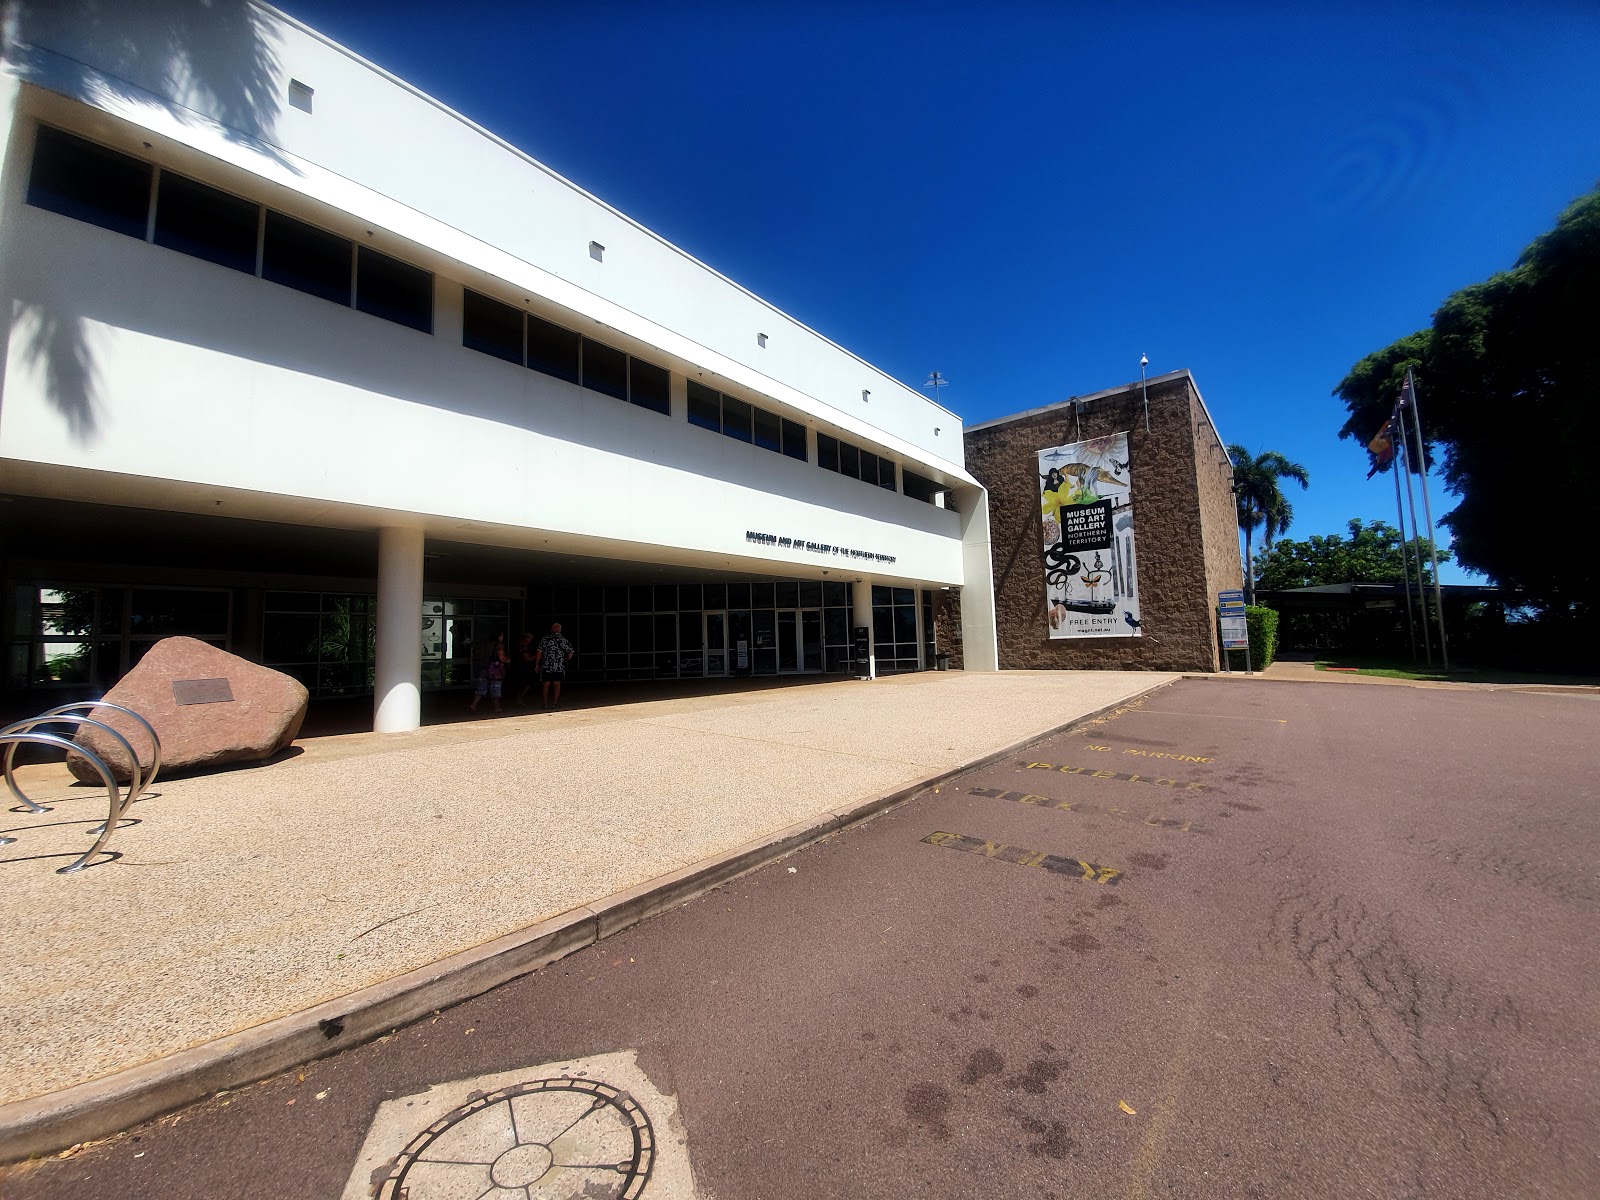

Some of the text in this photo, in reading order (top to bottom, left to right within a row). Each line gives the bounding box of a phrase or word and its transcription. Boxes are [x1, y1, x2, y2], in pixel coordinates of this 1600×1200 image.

[1066, 507, 1105, 519] MUSEUM
[1067, 514, 1105, 526] AND ART
[1067, 521, 1106, 532] GALLERY
[1068, 529, 1107, 539] NORTHERN
[746, 531, 777, 544] MUSEUM
[778, 536, 792, 546] AND
[793, 539, 805, 549] ART
[806, 541, 832, 553] GALLERY
[832, 545, 840, 555] OF
[1069, 536, 1107, 545] TERRITORY
[1083, 744, 1216, 764] NO PARKING
